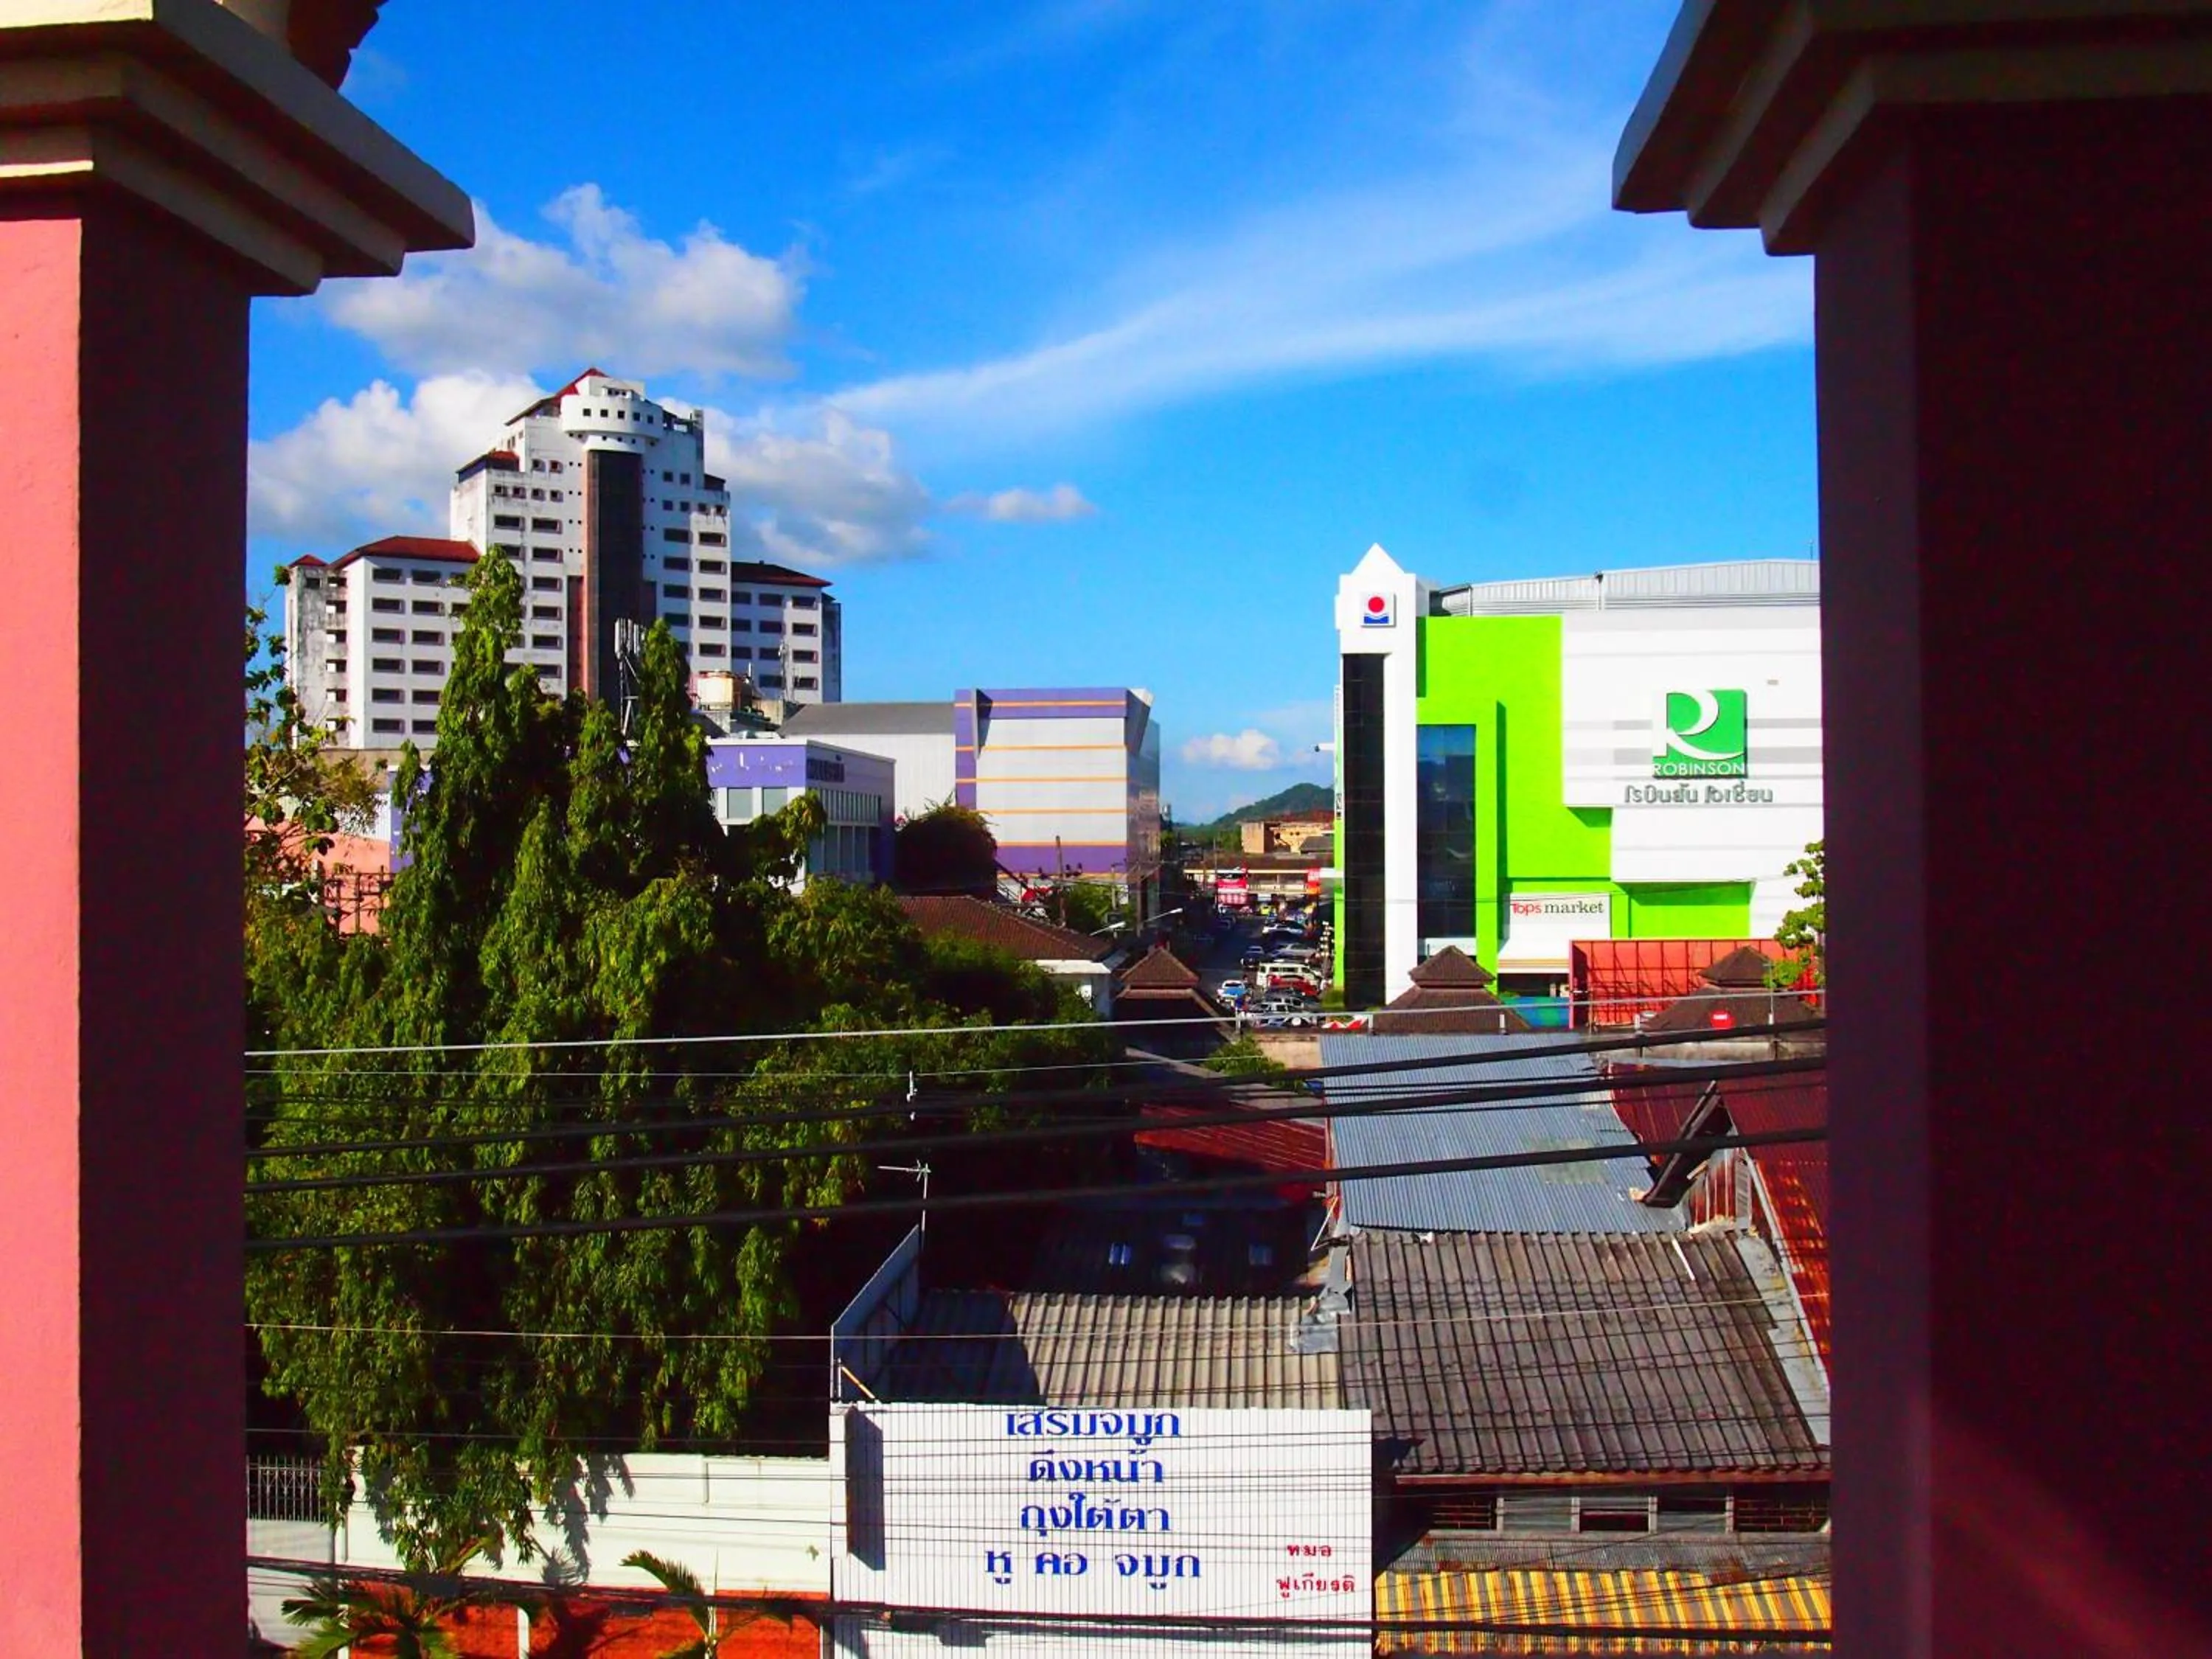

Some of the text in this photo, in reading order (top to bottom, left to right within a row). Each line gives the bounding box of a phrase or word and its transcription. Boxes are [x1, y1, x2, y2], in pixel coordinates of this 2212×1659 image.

[1653, 762, 1745, 776] ROBINSON
[1624, 780, 1773, 803] โรบินสัน โอเชี่ยน
[1512, 900, 1604, 916] Tops market
[1007, 1407, 1180, 1446] เสริมจมูก
[1028, 1448, 1165, 1483] ดึงหน้า
[985, 1551, 1201, 1590] หู คอ จมูก
